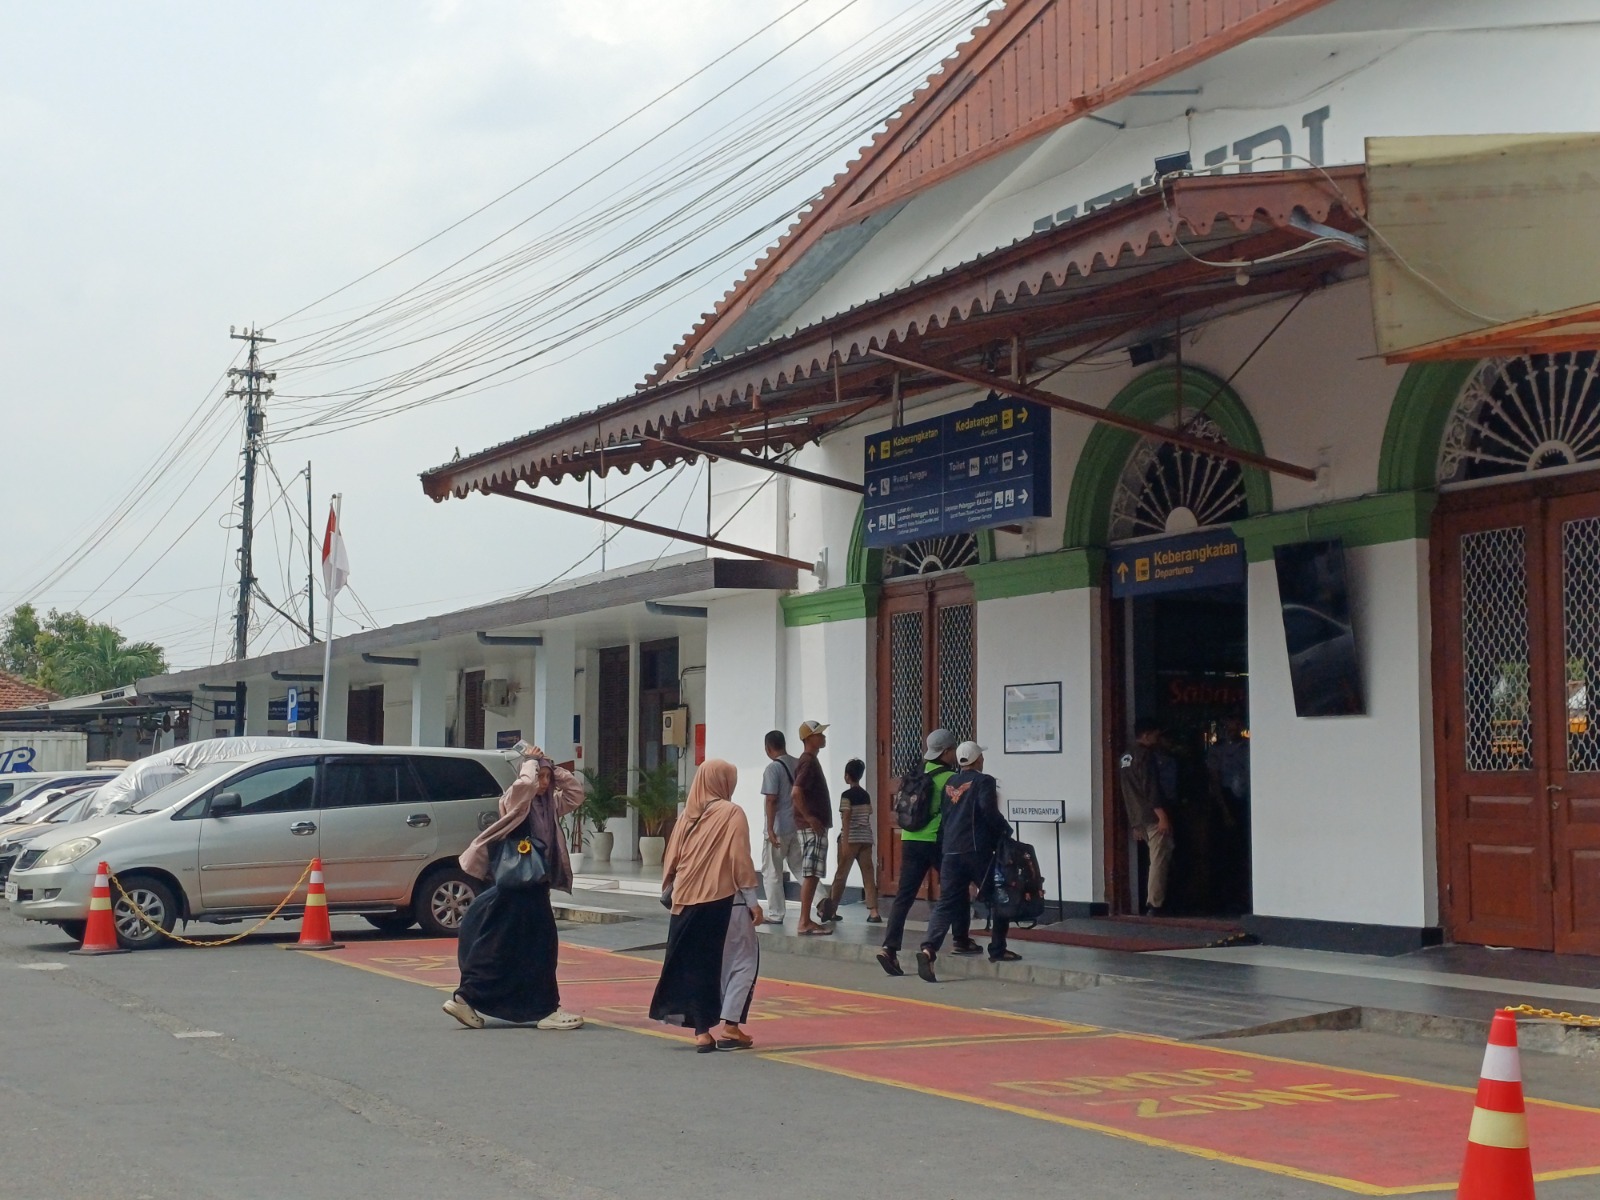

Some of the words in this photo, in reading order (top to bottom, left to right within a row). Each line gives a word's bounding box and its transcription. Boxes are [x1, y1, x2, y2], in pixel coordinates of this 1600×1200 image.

[955, 414, 998, 432] Kedatangan
[893, 429, 939, 447] Keberangkatan
[949, 461, 966, 471] Toilet
[984, 454, 999, 466] ATM
[1154, 541, 1238, 566] Keberangkatan
[1154, 565, 1194, 579] Departures
[288, 688, 297, 720] P
[1012, 807, 1028, 815] BATAS
[1028, 807, 1059, 816] PENGANTAR
[991, 1067, 1256, 1097] DROP
[1085, 1083, 1402, 1119] ZONE
